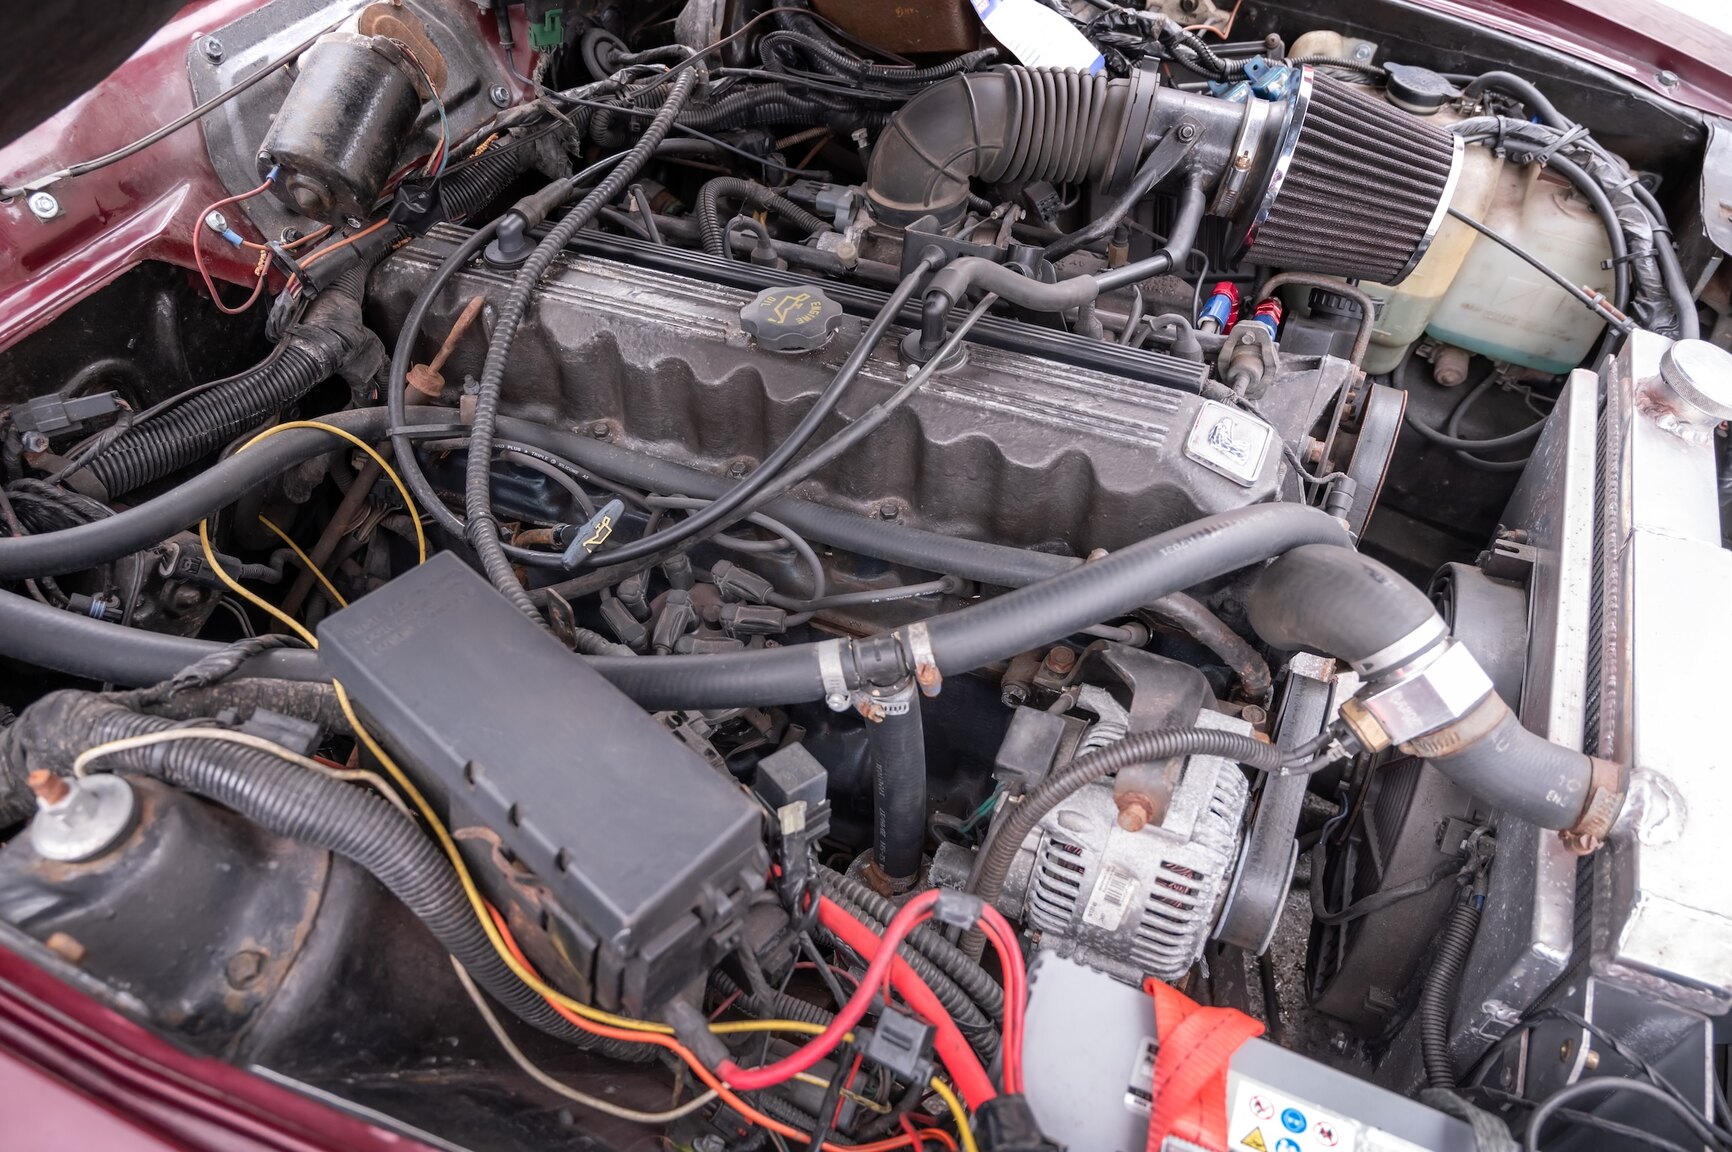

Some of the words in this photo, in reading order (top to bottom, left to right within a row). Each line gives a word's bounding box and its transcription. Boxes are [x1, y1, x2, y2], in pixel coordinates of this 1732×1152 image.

[760, 296, 777, 308] OIL
[795, 300, 822, 325] ENGINE
[507, 444, 522, 452] PLUS
[531, 451, 549, 461] TRIPLE
[558, 462, 580, 475] SILICONE
